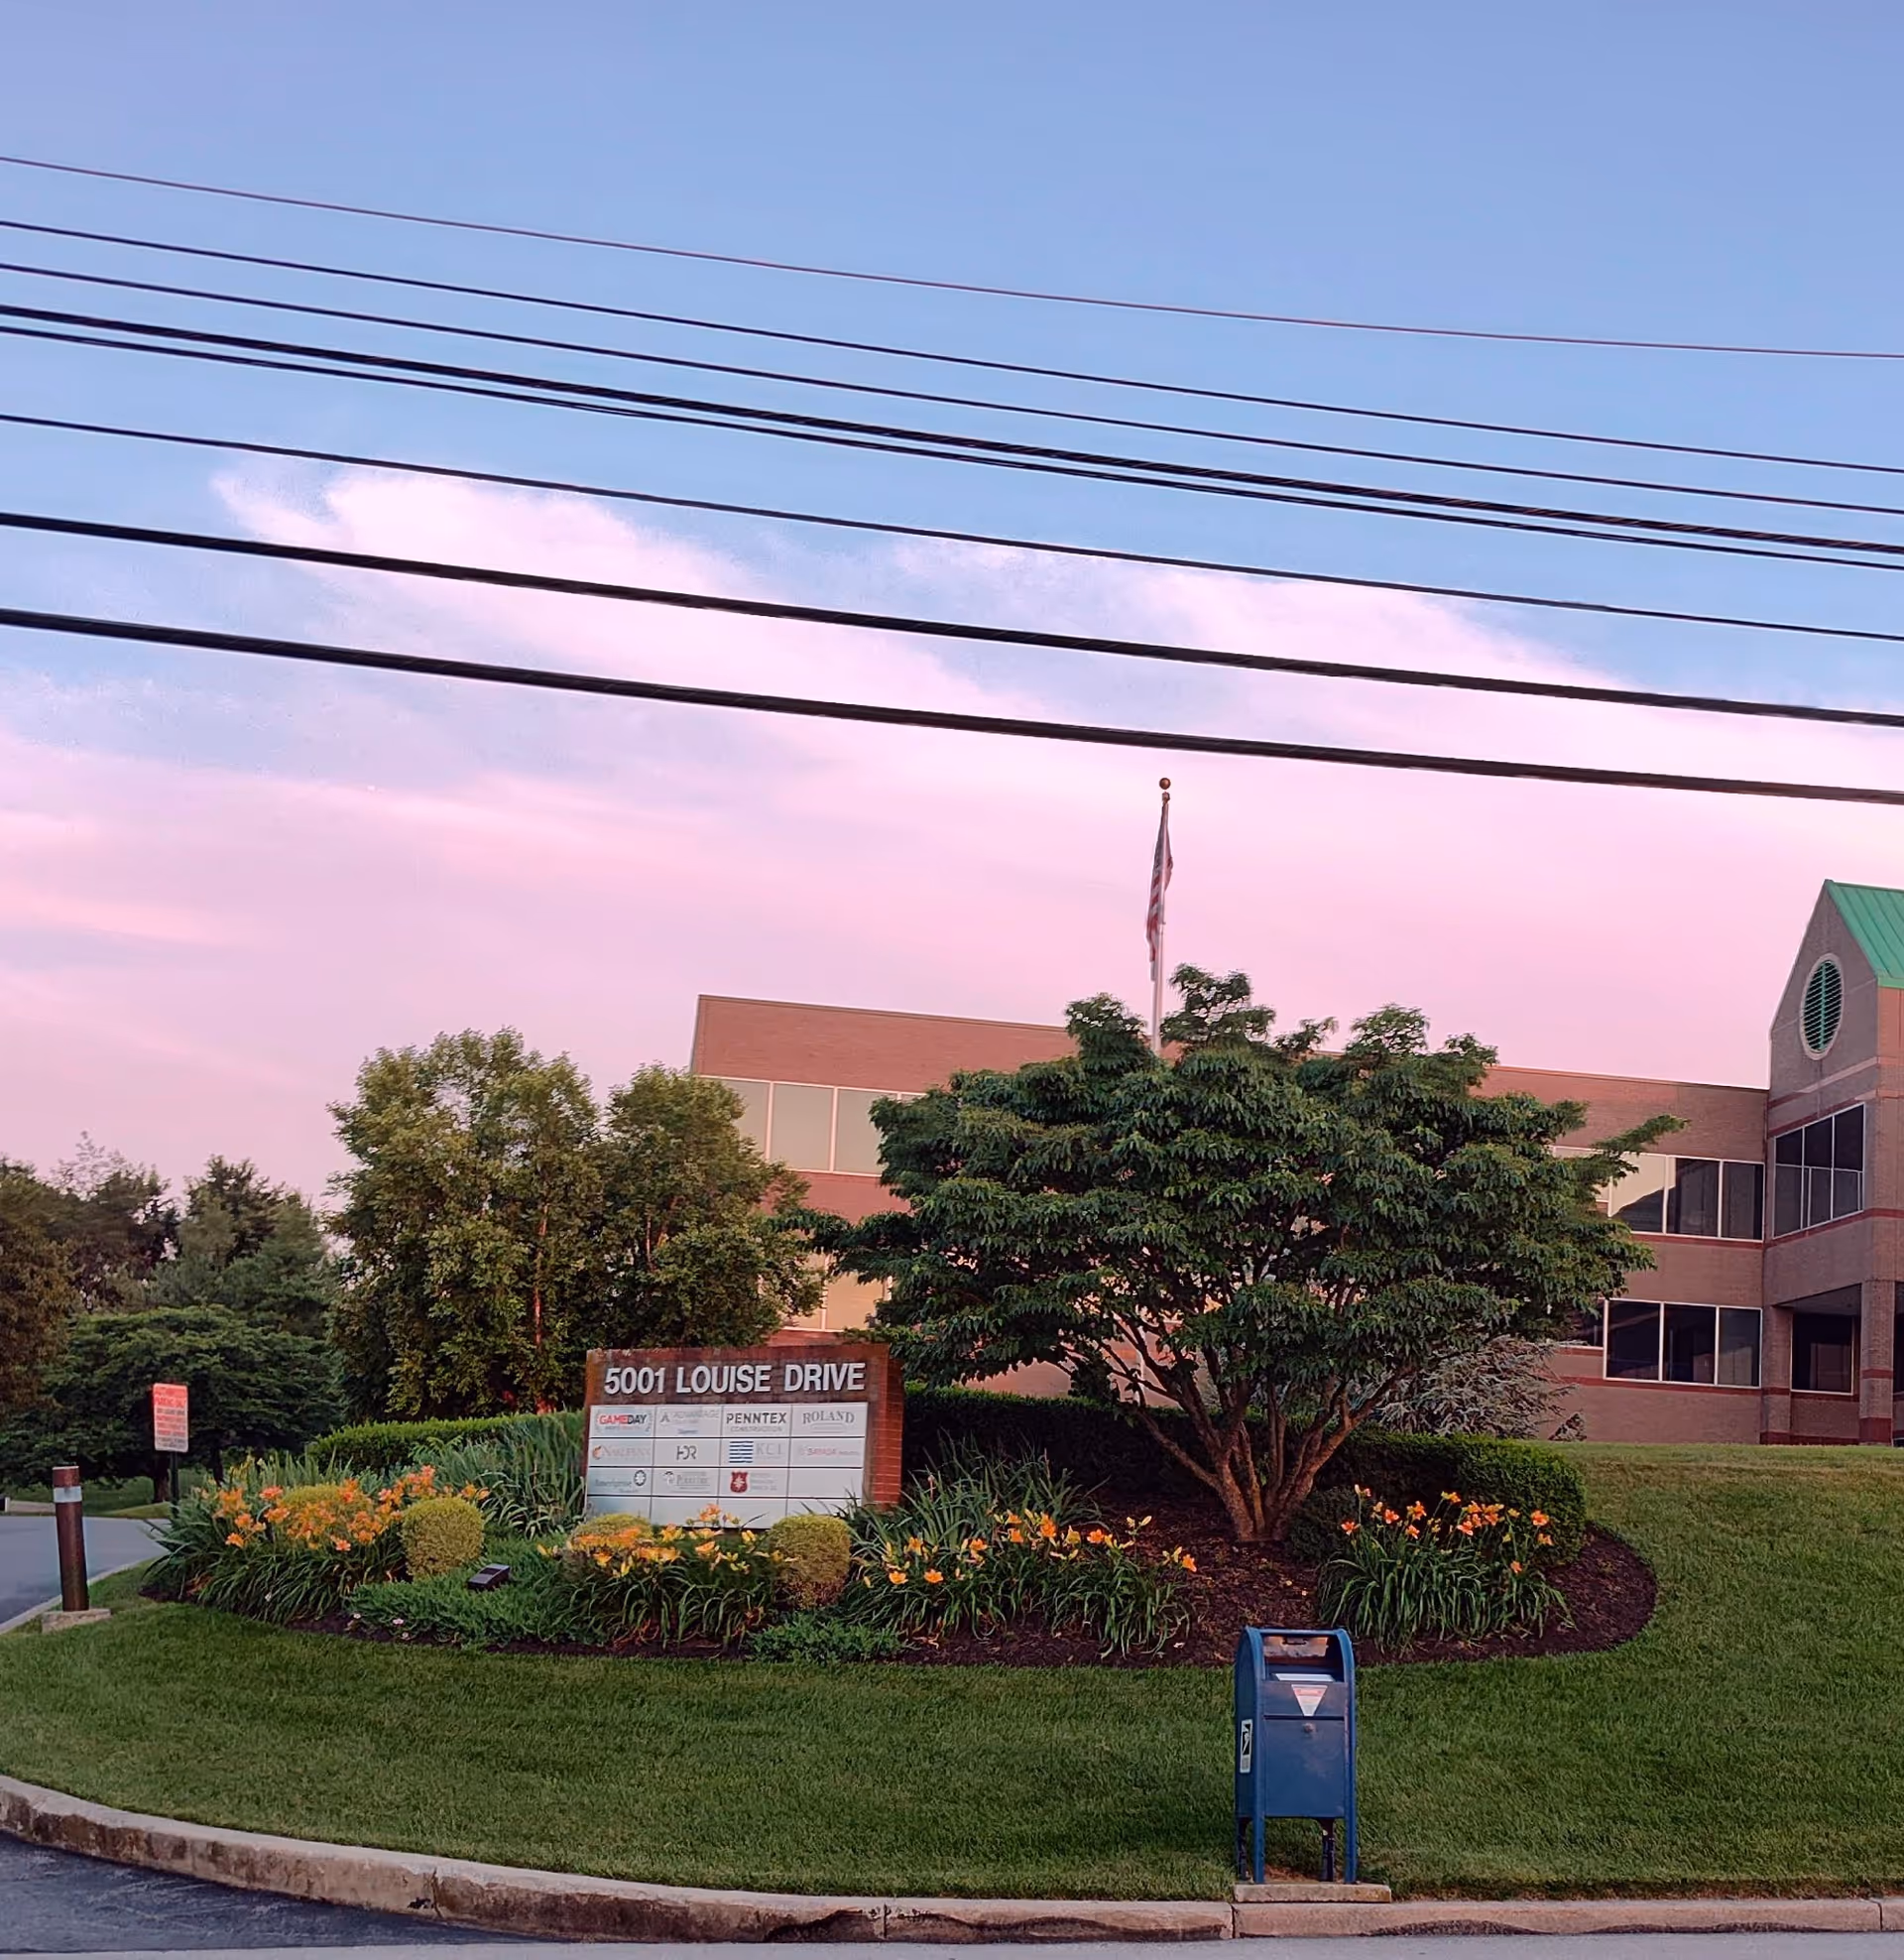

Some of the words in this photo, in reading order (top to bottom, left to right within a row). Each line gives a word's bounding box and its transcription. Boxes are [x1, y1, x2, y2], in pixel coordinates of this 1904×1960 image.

[604, 1367, 665, 1395] 5001
[675, 1364, 773, 1394] LOUISE
[783, 1362, 866, 1392] DRIVE
[598, 1413, 648, 1425] GAMEDAY
[726, 1412, 787, 1424] PENNTEX
[802, 1410, 855, 1424] ROLAND
